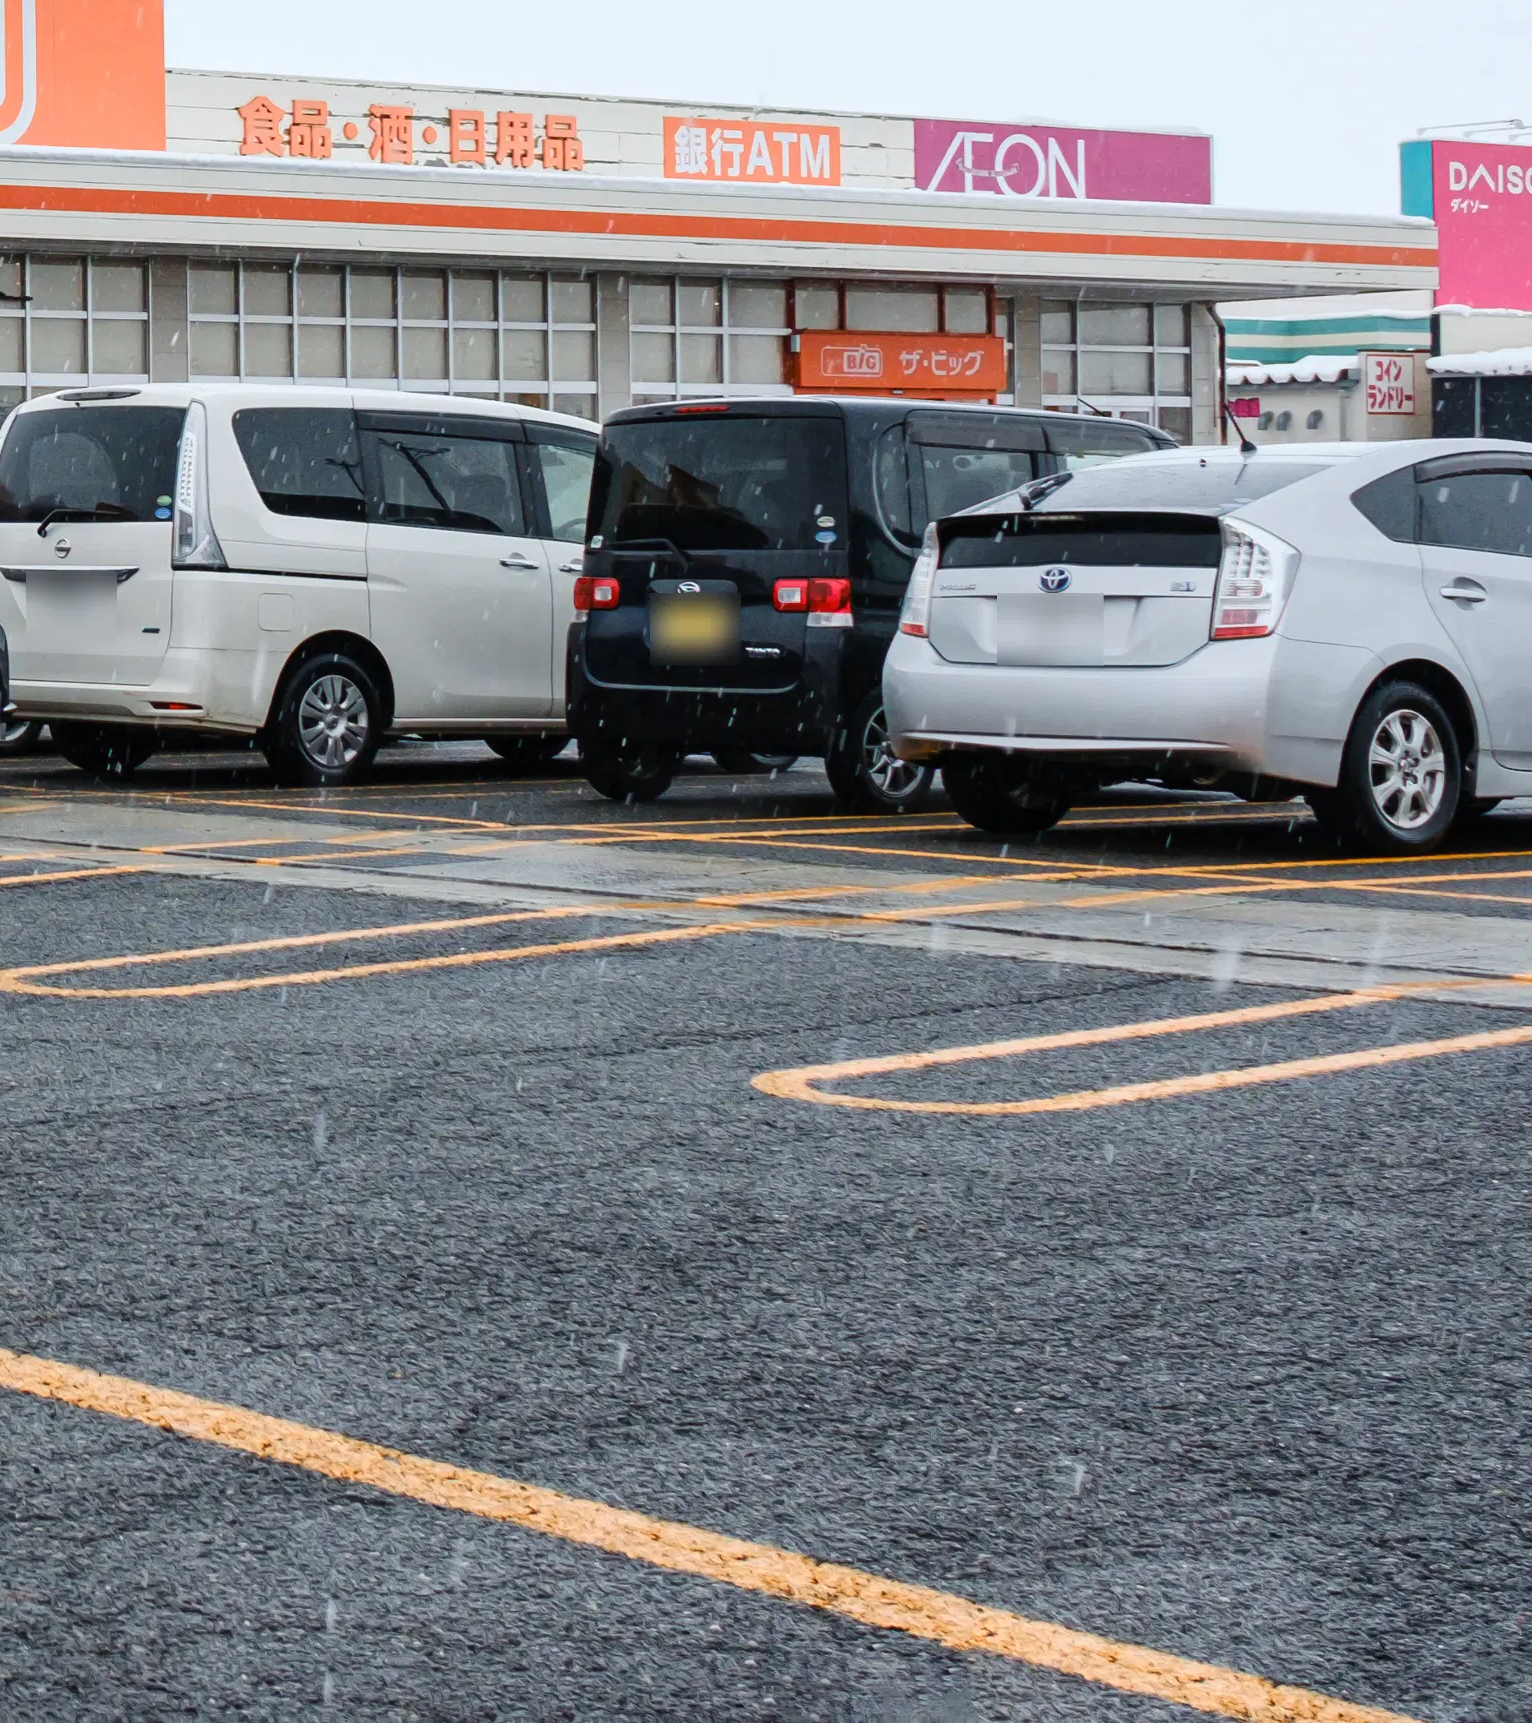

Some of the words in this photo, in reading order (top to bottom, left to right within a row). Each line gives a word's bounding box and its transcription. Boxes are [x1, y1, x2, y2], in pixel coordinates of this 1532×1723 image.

[238, 95, 584, 172] 食品・酒・日用品
[674, 126, 832, 181] 銀行ATM
[1449, 161, 1532, 195] DAIS
[1450, 198, 1489, 214] ダイソー
[899, 349, 984, 376] ザ・ビッグ
[1375, 360, 1402, 382] コイン
[1368, 384, 1413, 410] ランドリー
